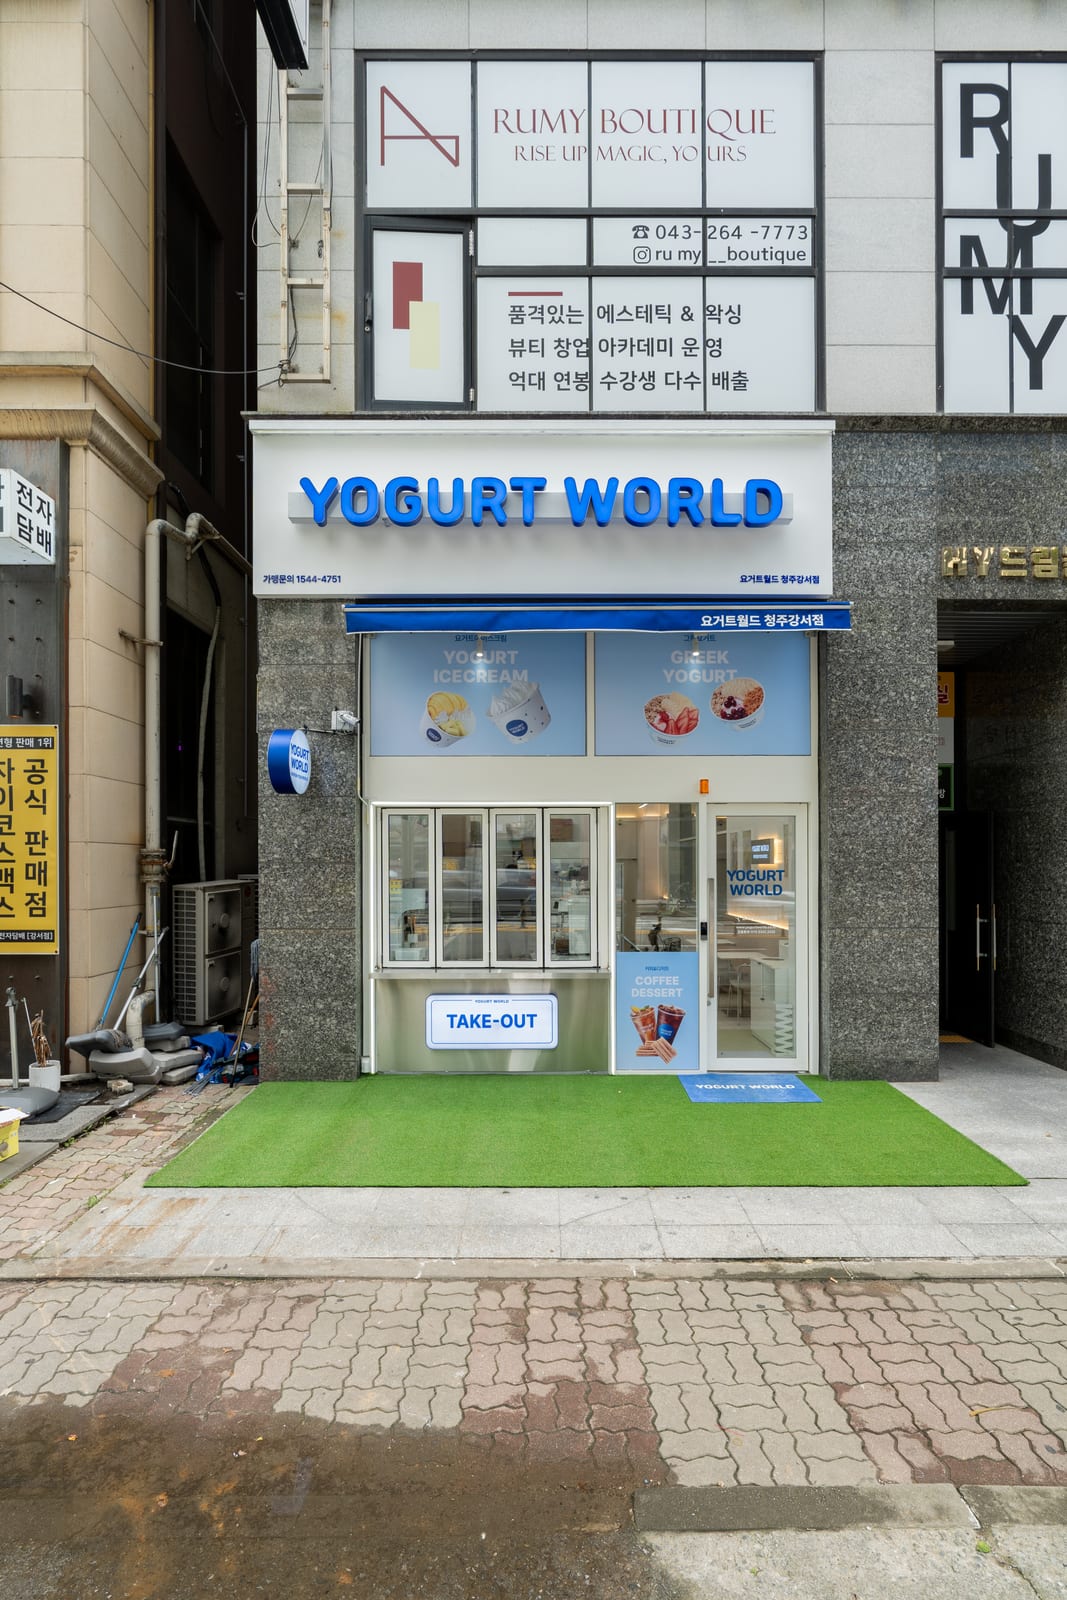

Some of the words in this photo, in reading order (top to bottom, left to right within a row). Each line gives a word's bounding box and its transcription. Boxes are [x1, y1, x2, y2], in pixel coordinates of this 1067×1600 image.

[493, 108, 586, 134] RUMY
[600, 108, 776, 141] BOUTIQUE
[514, 145, 557, 162] RISE
[562, 145, 587, 162] UP
[596, 145, 668, 164] MAGIC,
[508, 304, 584, 325] 품격있는
[596, 304, 672, 324] 에스테틱
[680, 305, 695, 322] &
[705, 304, 742, 325] 왁싱
[508, 337, 545, 358] 뷰티
[553, 337, 590, 358] 창업
[598, 337, 673, 357] 아카데미
[508, 371, 546, 391] 억대
[553, 371, 590, 391] 연봉
[600, 370, 656, 391] 수강생
[664, 370, 702, 391] 다수
[712, 370, 749, 391] 배출
[16, 480, 52, 526] 전자
[299, 476, 547, 528] YOGURT
[563, 476, 784, 528] WORLD
[16, 511, 52, 557] 담배
[942, 545, 1067, 578] HY드림
[263, 574, 295, 585] 가맹문의
[296, 575, 342, 584] 1544-4751
[739, 574, 780, 584] 요거트월드
[780, 574, 820, 585] 청주강서점
[700, 614, 762, 628] 요거트월드
[763, 613, 824, 628] 청주강서점
[444, 650, 519, 665] YOGURT
[671, 650, 729, 665] GREEK
[433, 669, 529, 684] ICECREAM
[663, 669, 738, 683] YOGURT
[16, 737, 34, 748] 판매
[37, 737, 52, 748] 1위
[291, 743, 310, 761] YOGURT
[291, 758, 309, 774] WORLD
[23, 758, 49, 816] 공식
[24, 829, 49, 918] 판매점
[726, 869, 785, 881] YOGURT
[729, 884, 783, 896] WORLD
[635, 975, 680, 986] COFFEE
[631, 988, 683, 998] DESSERT
[446, 1013, 538, 1029] TAKE-OUT
